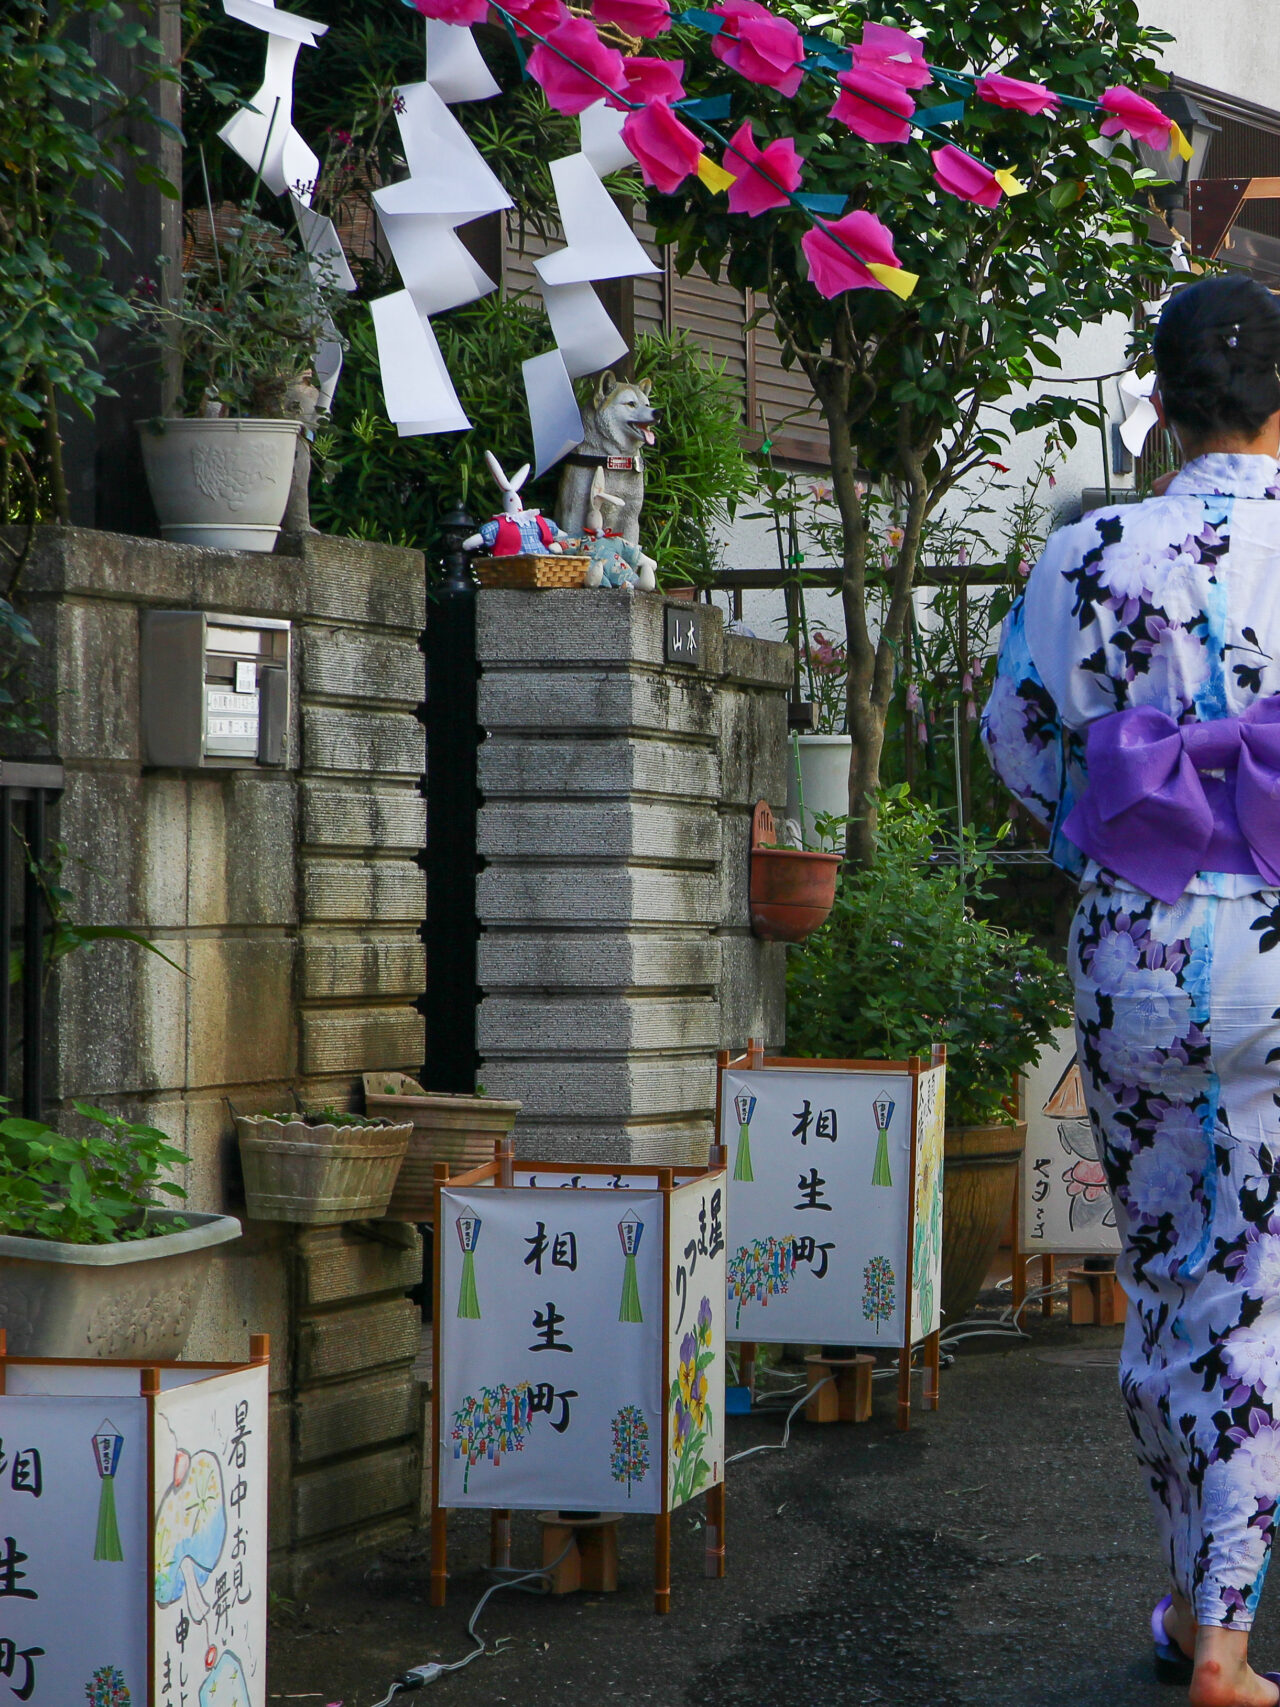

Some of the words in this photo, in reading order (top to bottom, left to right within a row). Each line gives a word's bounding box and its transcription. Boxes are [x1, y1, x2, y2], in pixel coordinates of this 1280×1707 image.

[672, 619, 698, 656] 山本
[675, 1188, 725, 1335] 星まつり
[792, 1099, 838, 1280] 相生町
[523, 1220, 578, 1434] 相生町
